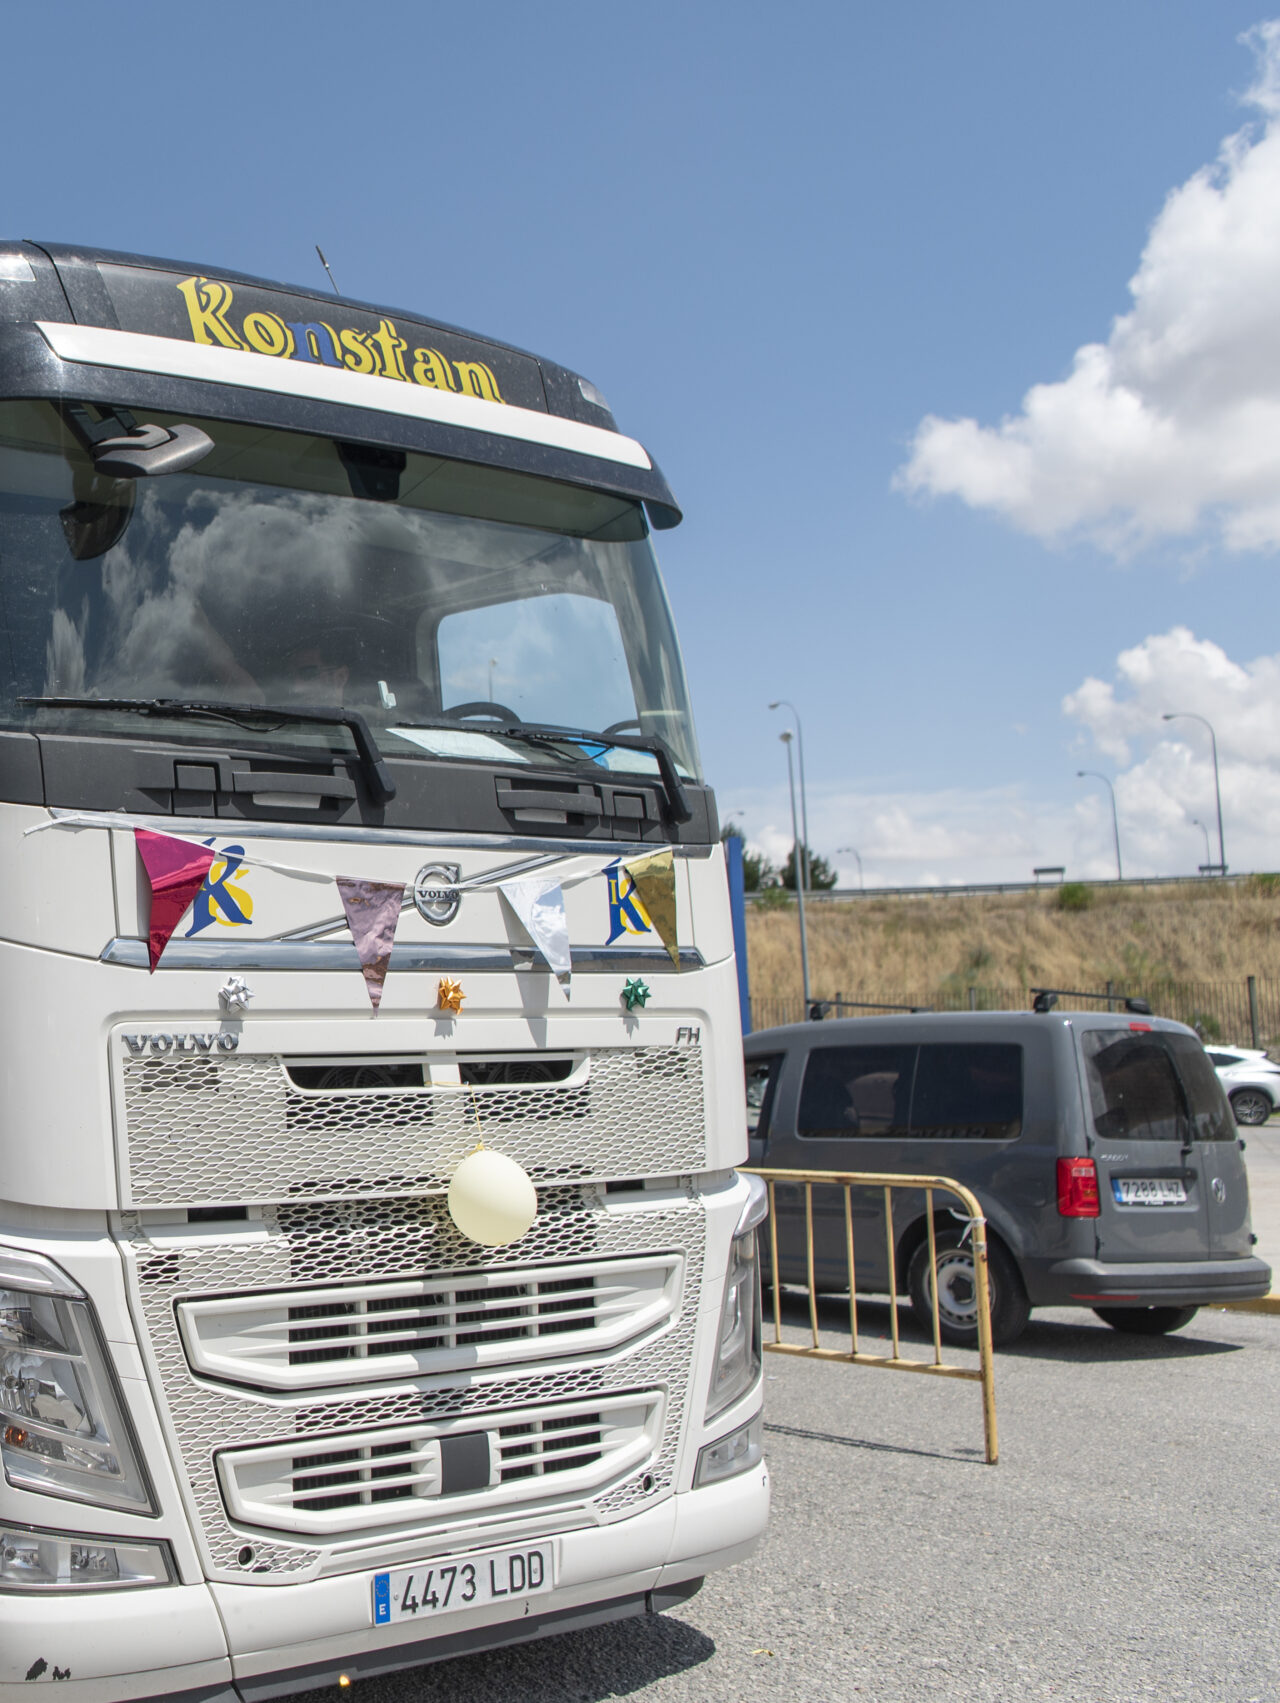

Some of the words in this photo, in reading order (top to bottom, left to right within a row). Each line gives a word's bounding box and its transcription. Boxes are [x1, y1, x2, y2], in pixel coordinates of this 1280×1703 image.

[177, 277, 506, 404] Konstan
[417, 890, 459, 899] VOLVO
[121, 1033, 240, 1055] VOLVO
[676, 1026, 700, 1044] FH
[379, 1603, 387, 1616] E
[401, 1563, 476, 1614] 4473
[490, 1550, 544, 1597] LDD
